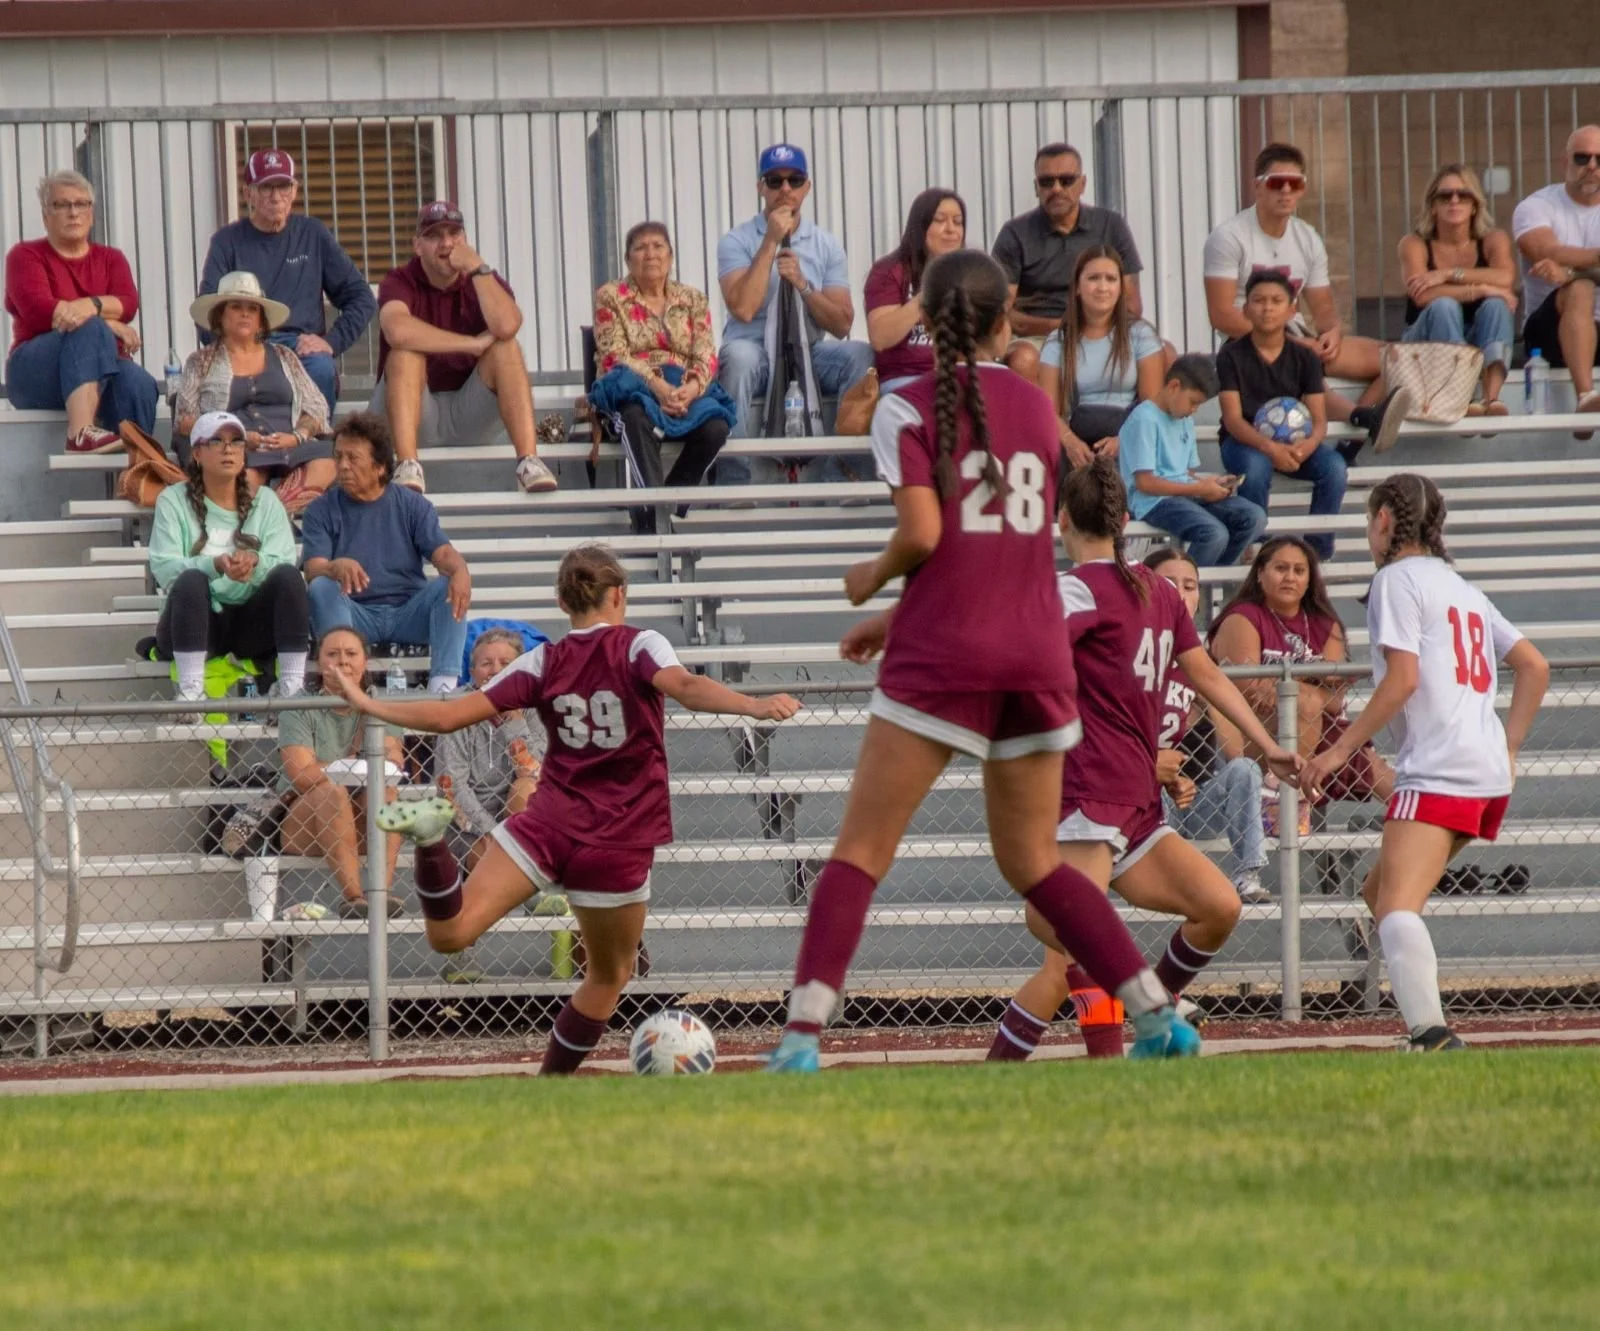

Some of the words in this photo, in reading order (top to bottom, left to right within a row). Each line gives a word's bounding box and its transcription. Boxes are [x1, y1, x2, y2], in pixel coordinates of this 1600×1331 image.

[960, 450, 1045, 534] 28
[1448, 605, 1492, 695] 18
[552, 690, 627, 749] 39
